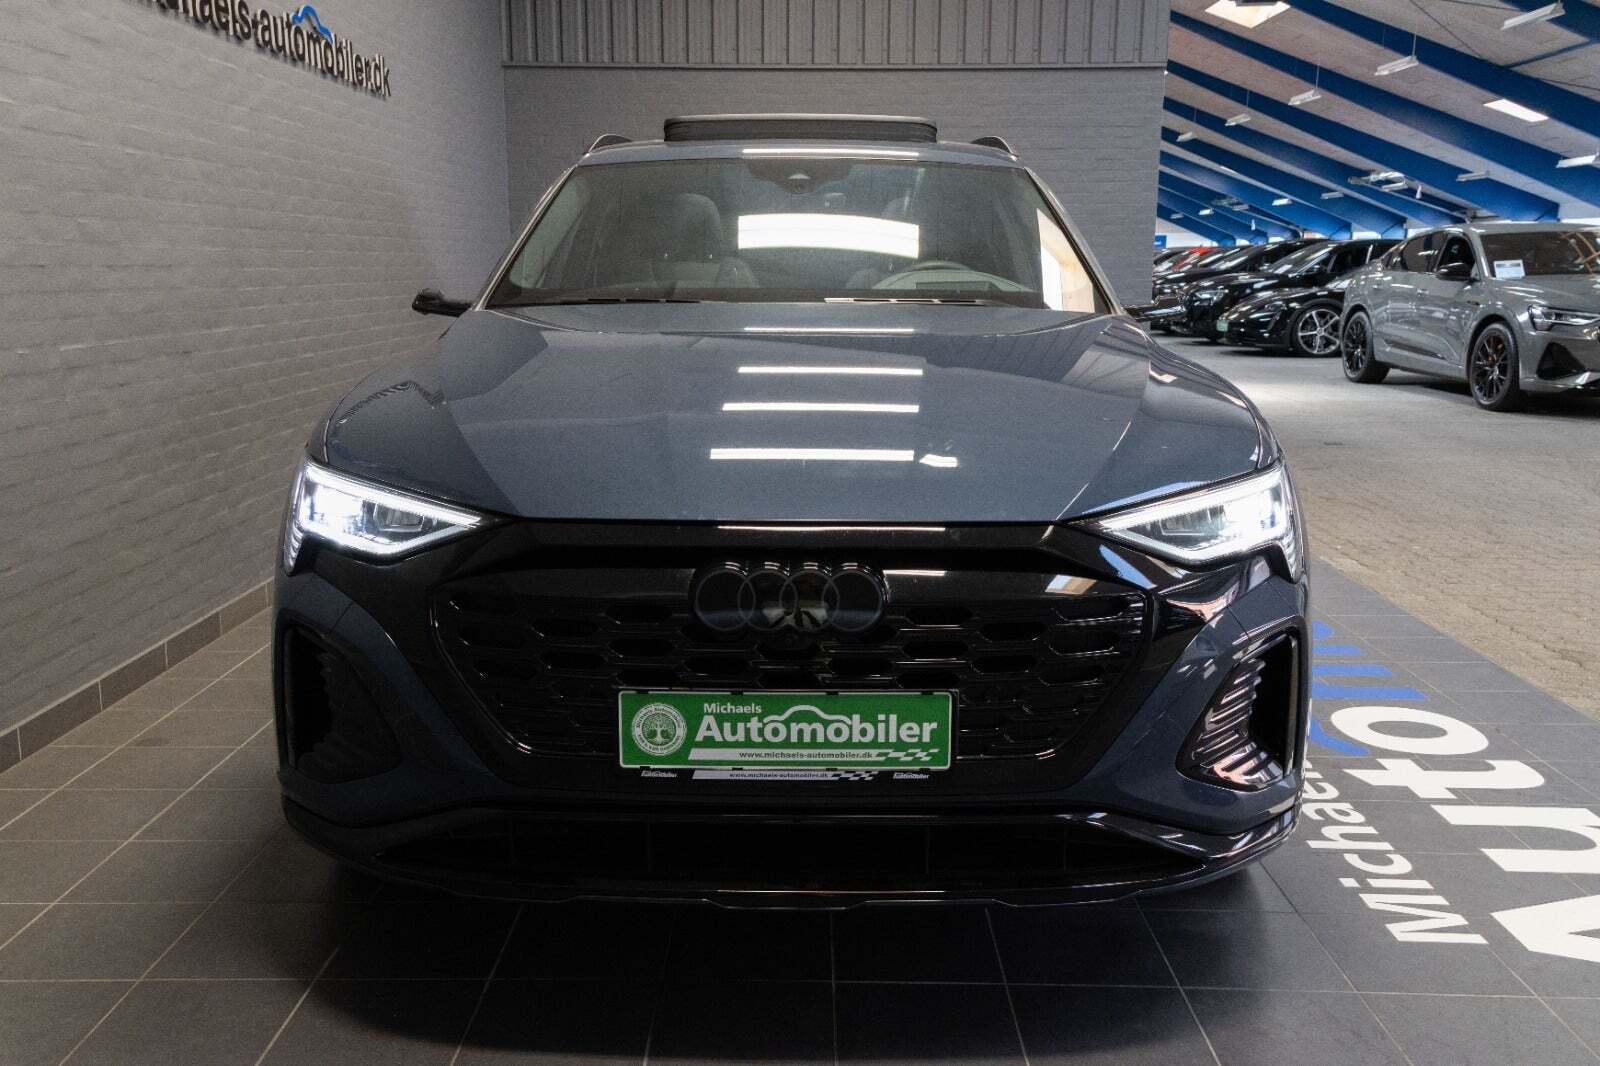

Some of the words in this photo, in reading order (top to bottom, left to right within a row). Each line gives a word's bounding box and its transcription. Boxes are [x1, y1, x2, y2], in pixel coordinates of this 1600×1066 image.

[703, 702, 762, 714] Michaels
[694, 714, 938, 743] Automobiler
[739, 751, 873, 759] www.michaels-automobiler.dk
